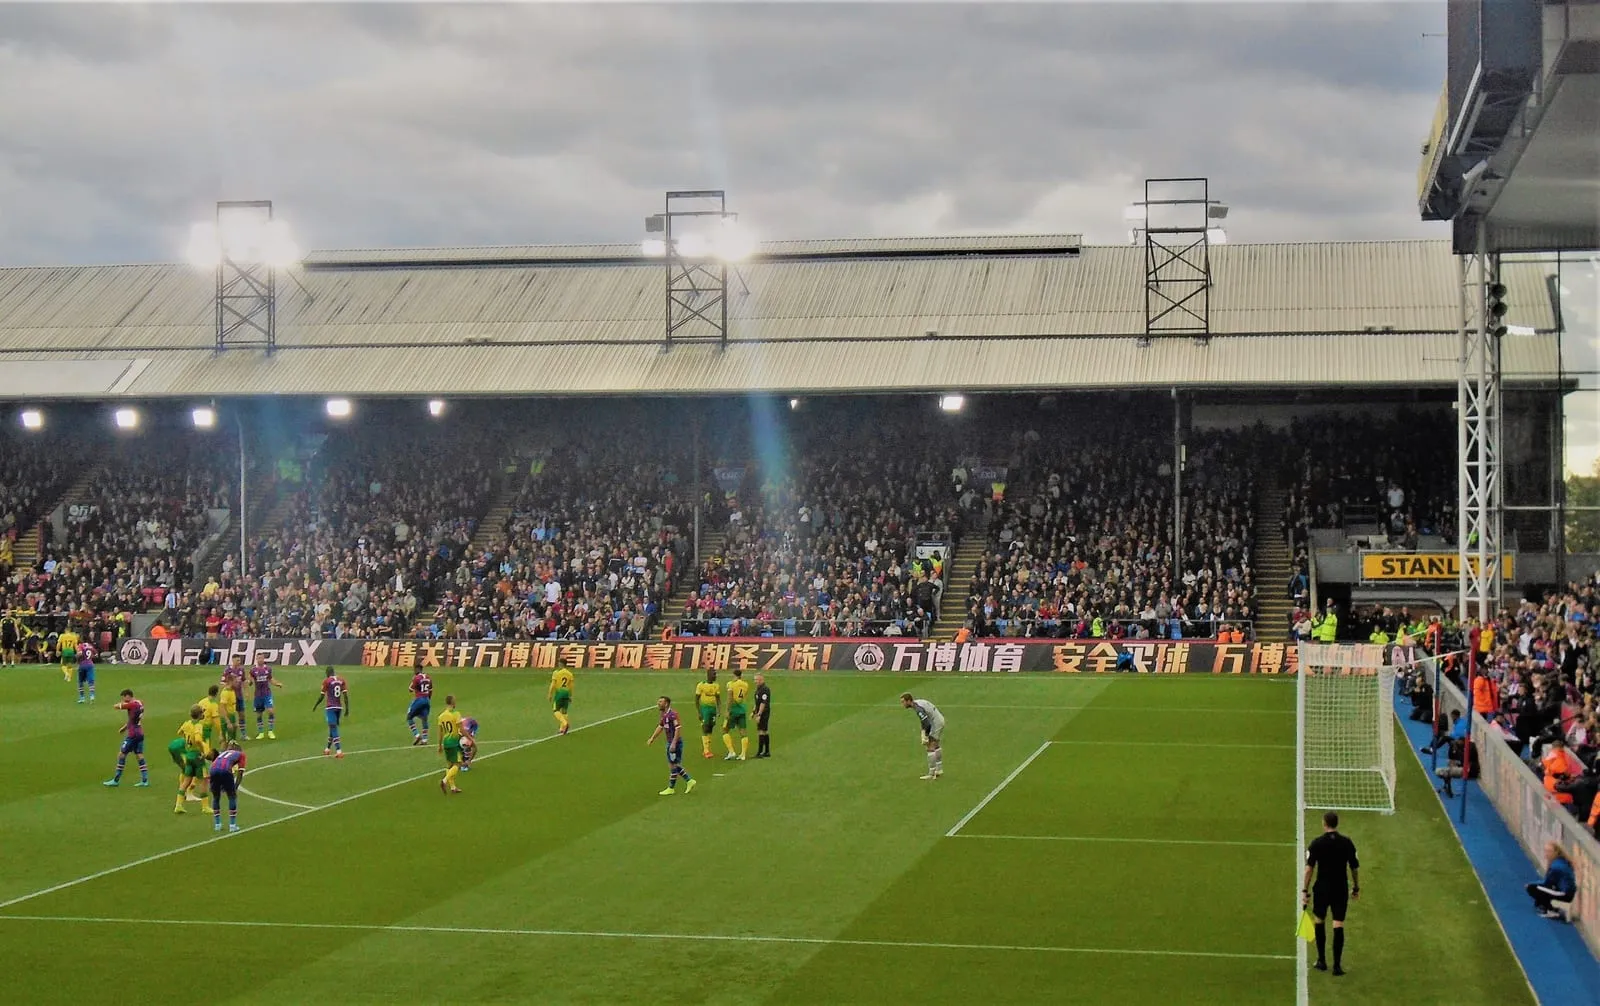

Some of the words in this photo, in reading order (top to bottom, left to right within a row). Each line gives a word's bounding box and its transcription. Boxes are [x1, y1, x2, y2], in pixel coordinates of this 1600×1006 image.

[86, 650, 91, 660] 9
[891, 642, 1025, 672] 万博体育
[561, 677, 568, 688] 2
[334, 685, 341, 698] 8
[420, 683, 430, 694] 15
[738, 688, 744, 699] 4
[441, 721, 453, 734] 10
